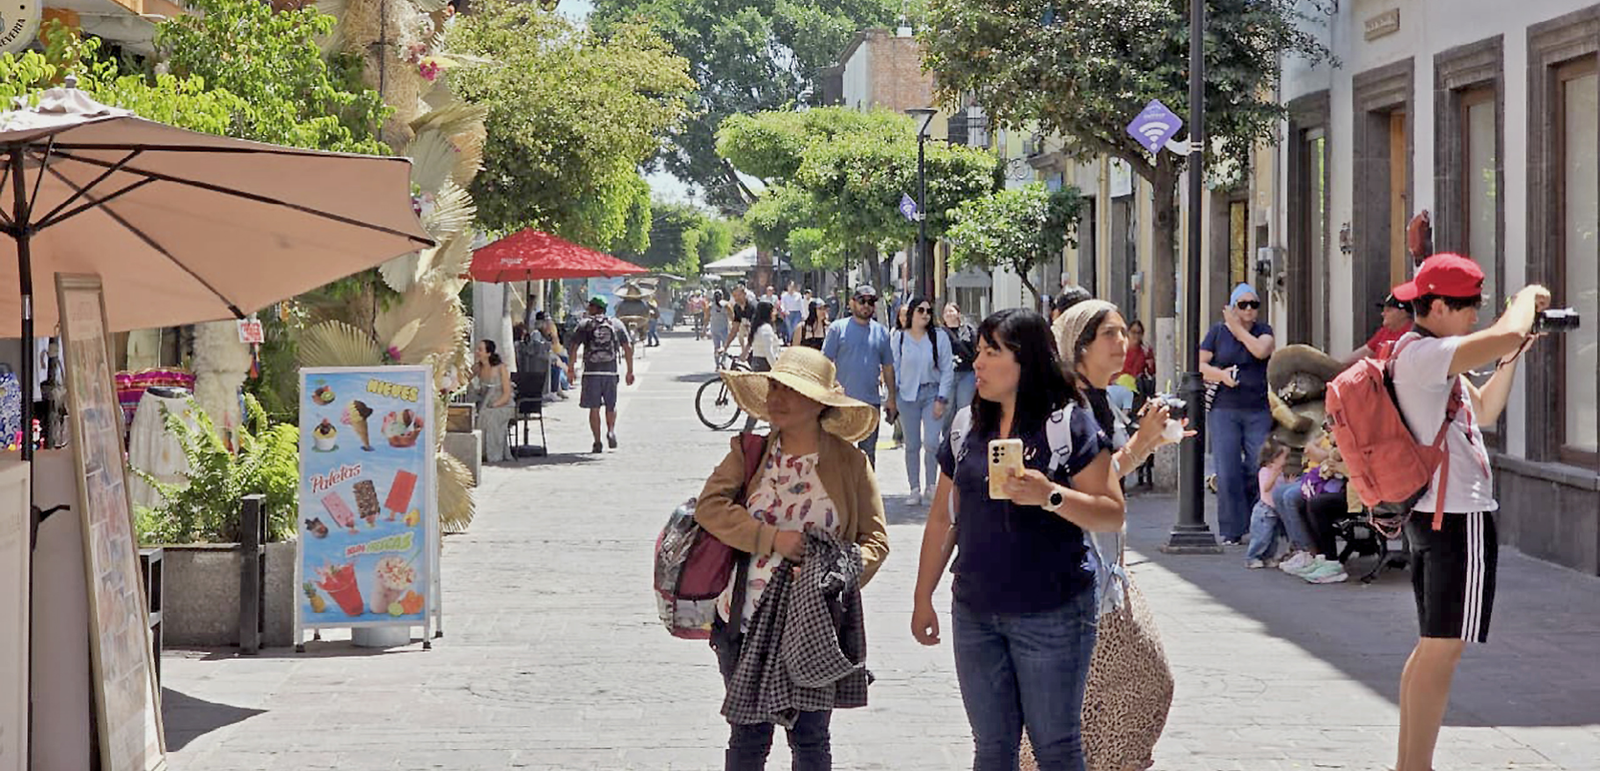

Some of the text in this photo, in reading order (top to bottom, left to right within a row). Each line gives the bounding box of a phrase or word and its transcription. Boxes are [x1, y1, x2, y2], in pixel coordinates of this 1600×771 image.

[0, 18, 26, 47] EVERIA
[367, 380, 419, 402] NIEVES
[310, 464, 361, 493] Paletas
